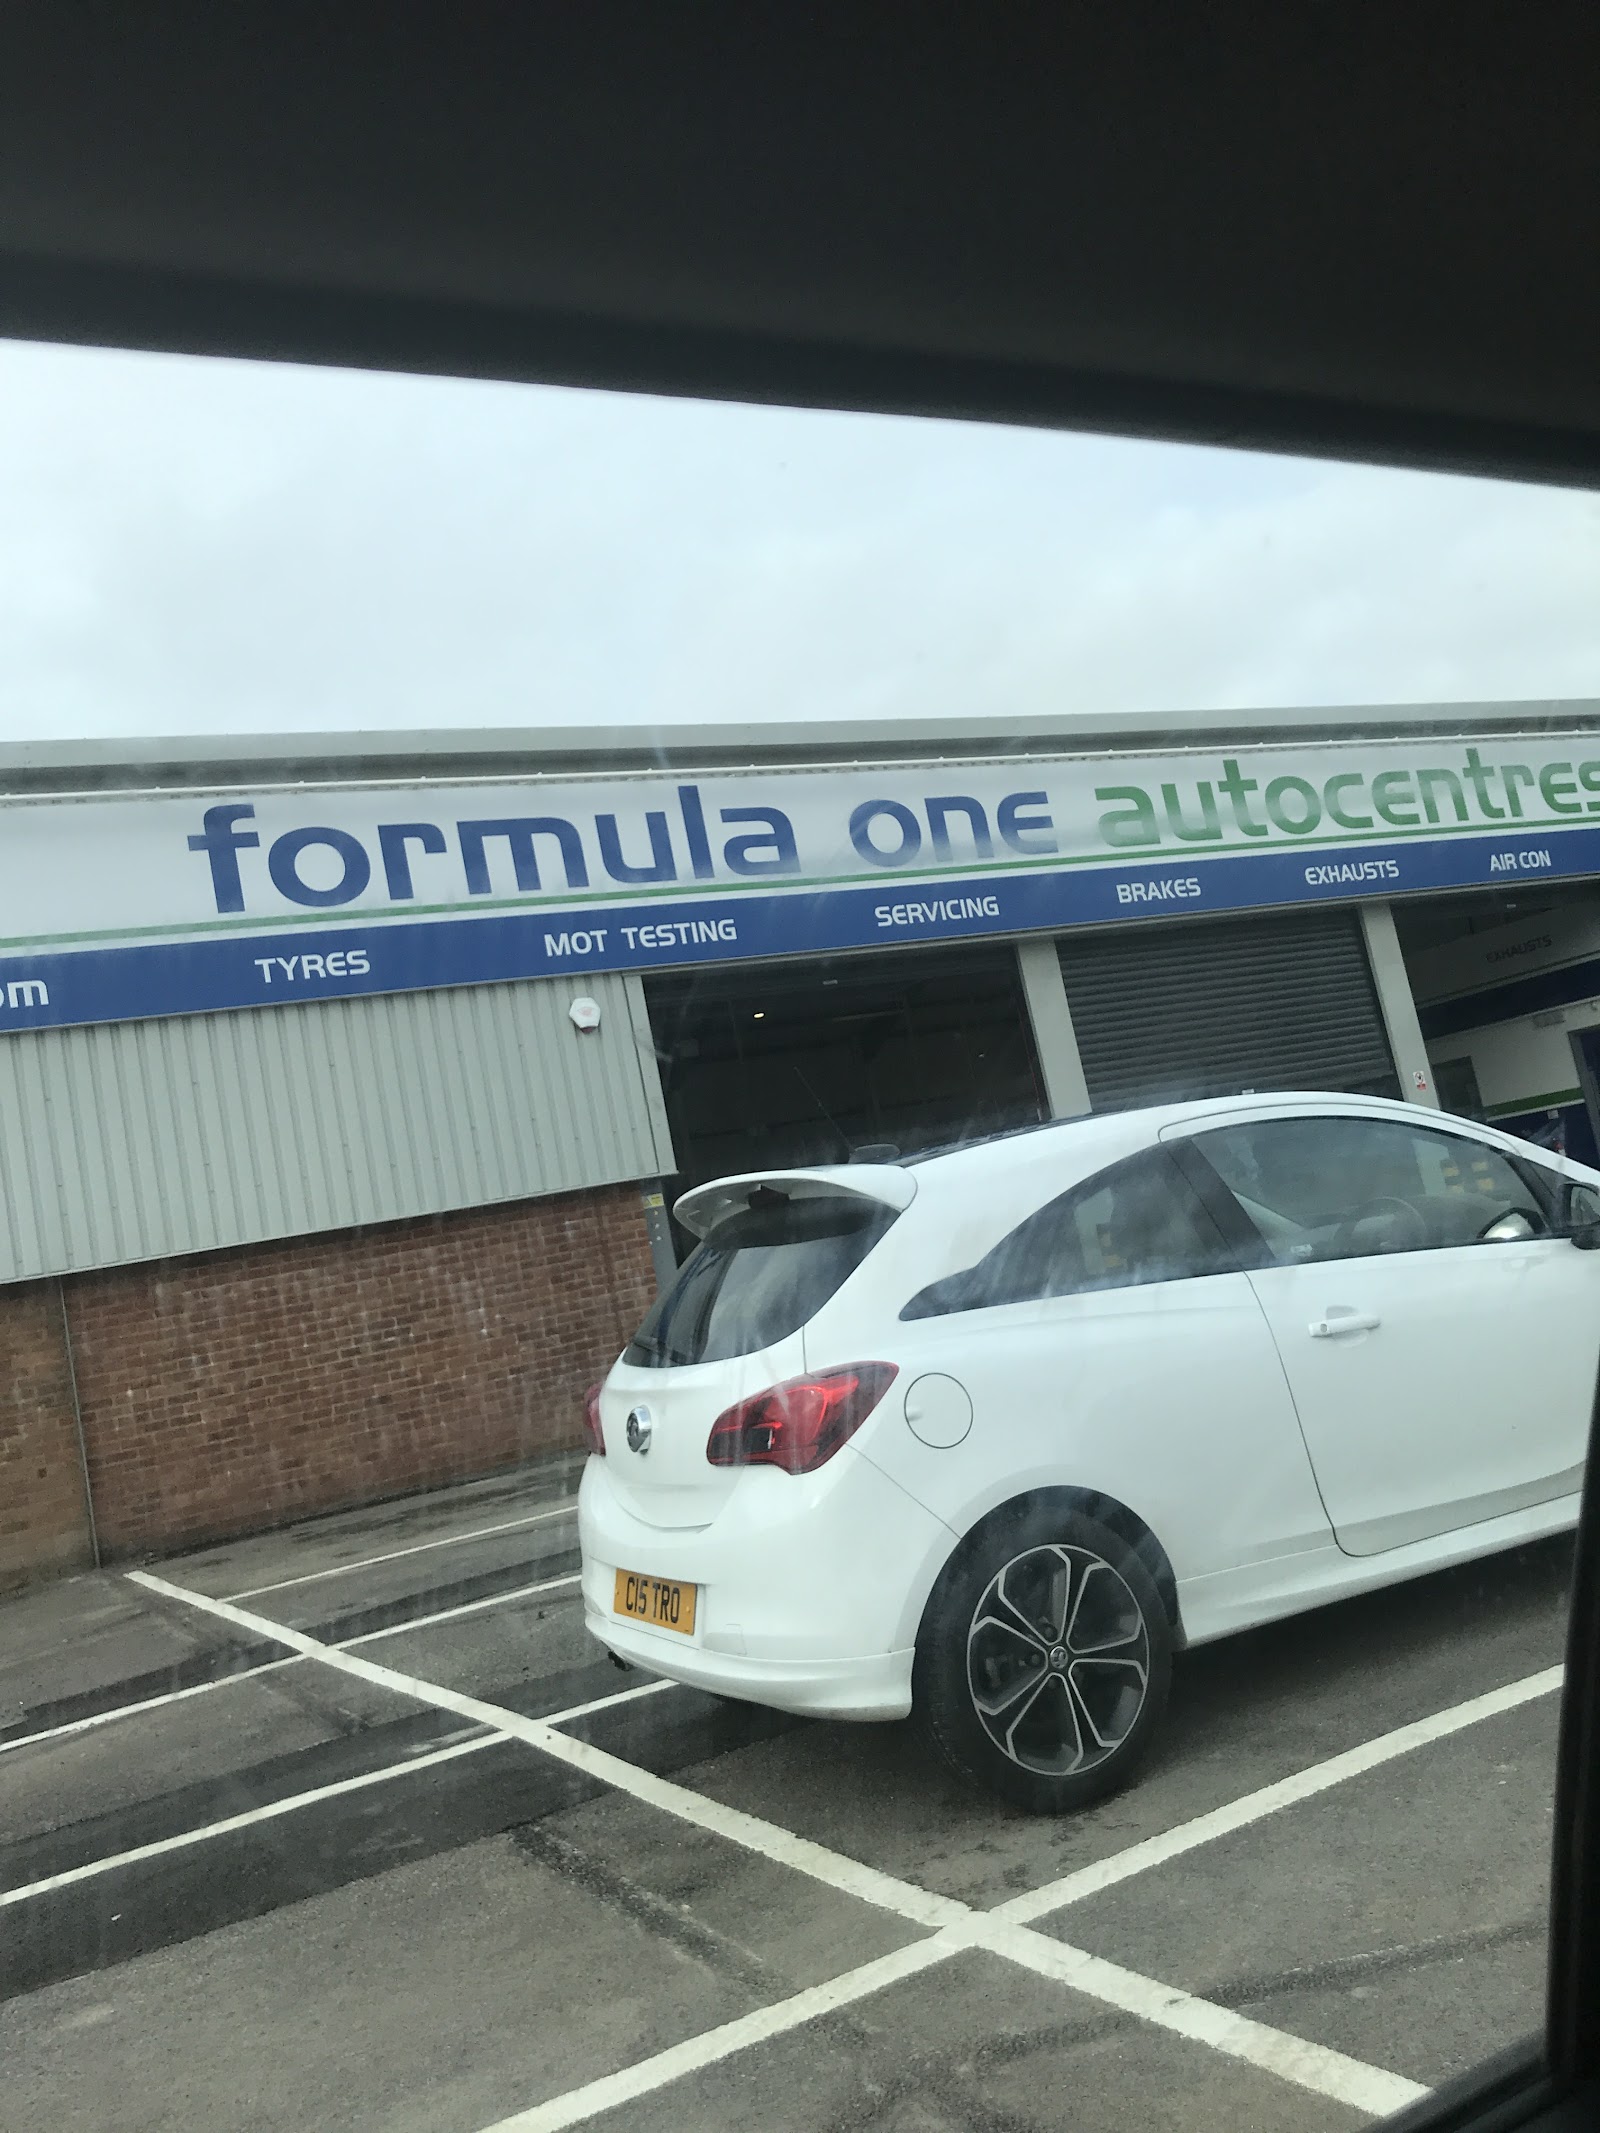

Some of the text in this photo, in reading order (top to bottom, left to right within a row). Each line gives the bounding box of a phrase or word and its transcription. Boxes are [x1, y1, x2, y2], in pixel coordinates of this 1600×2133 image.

[187, 785, 801, 913] formula
[849, 791, 1059, 868] one
[1490, 849, 1552, 872] AIR CON
[1304, 859, 1400, 885] EXHAUSTS
[1116, 877, 1202, 904] BRAKES
[874, 895, 1000, 927] SERVICING
[543, 918, 738, 957] MOT TESTING
[254, 949, 371, 983] TYRES
[652, 1581, 680, 1624] TRO
